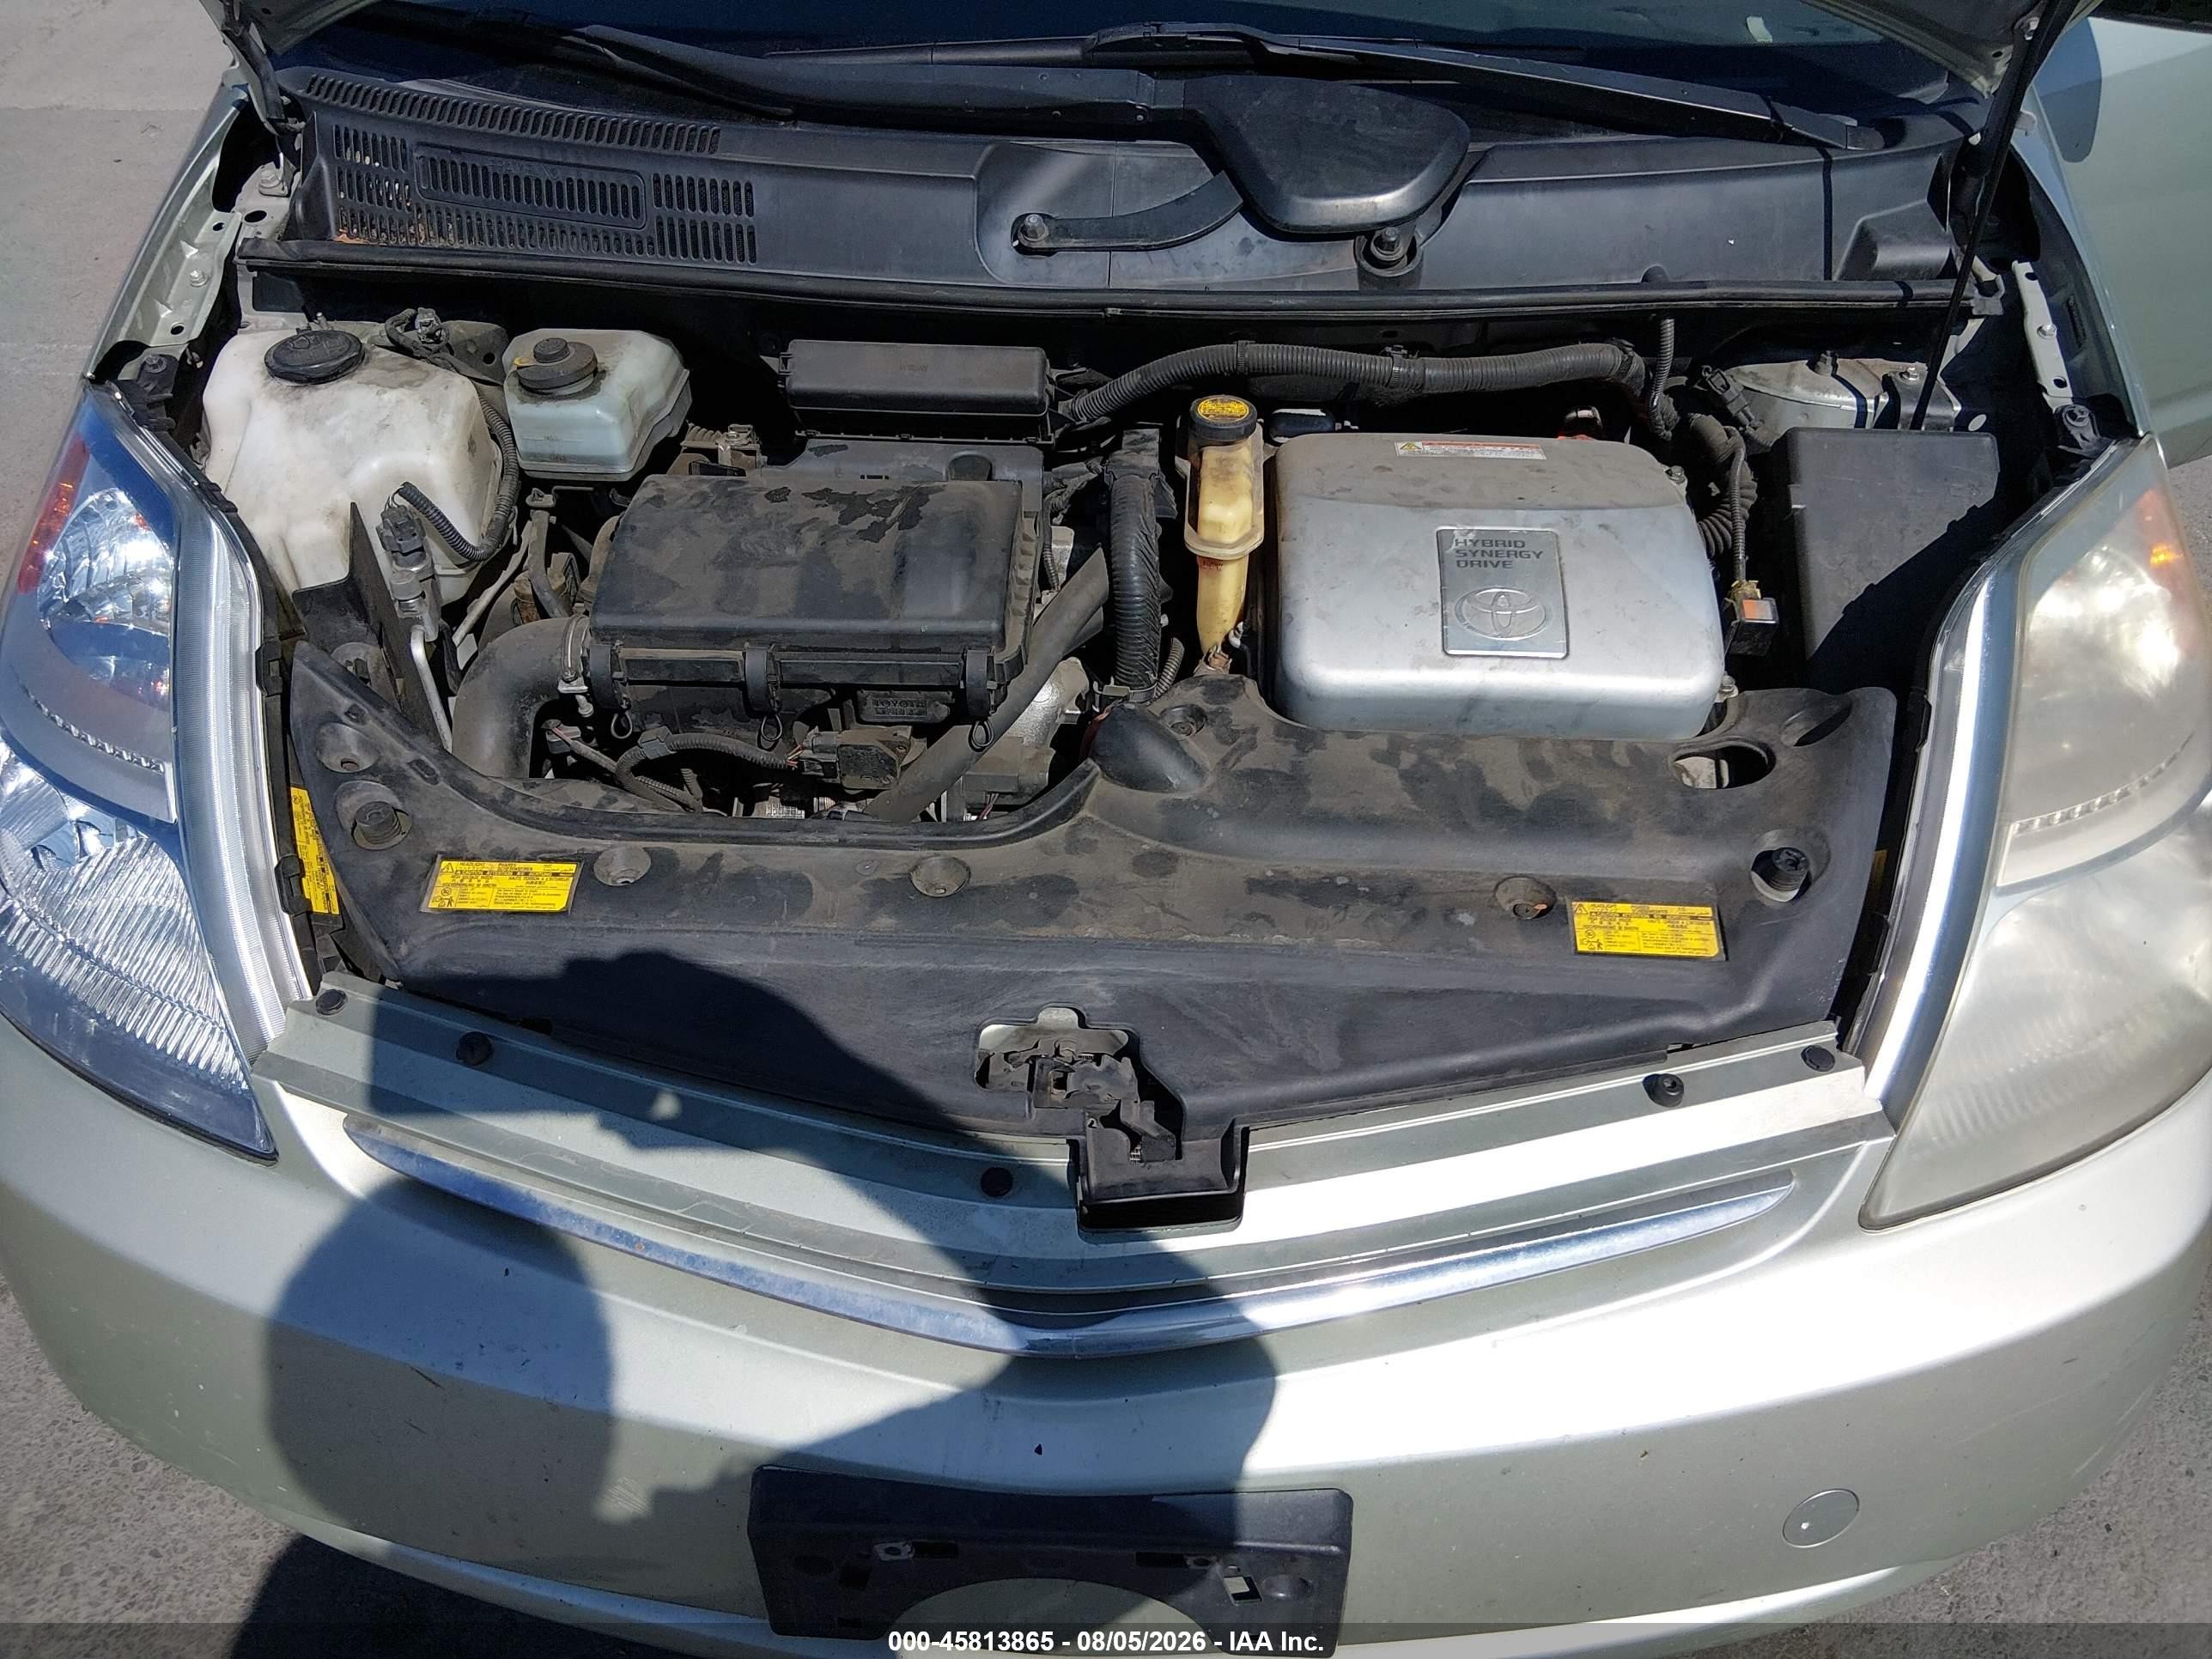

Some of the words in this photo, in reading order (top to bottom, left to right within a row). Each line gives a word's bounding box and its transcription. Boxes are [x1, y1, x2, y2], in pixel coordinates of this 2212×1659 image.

[1454, 538, 1526, 549] HYBRID
[1455, 549, 1543, 559] SYNERGY
[1455, 559, 1513, 569] DRIVE
